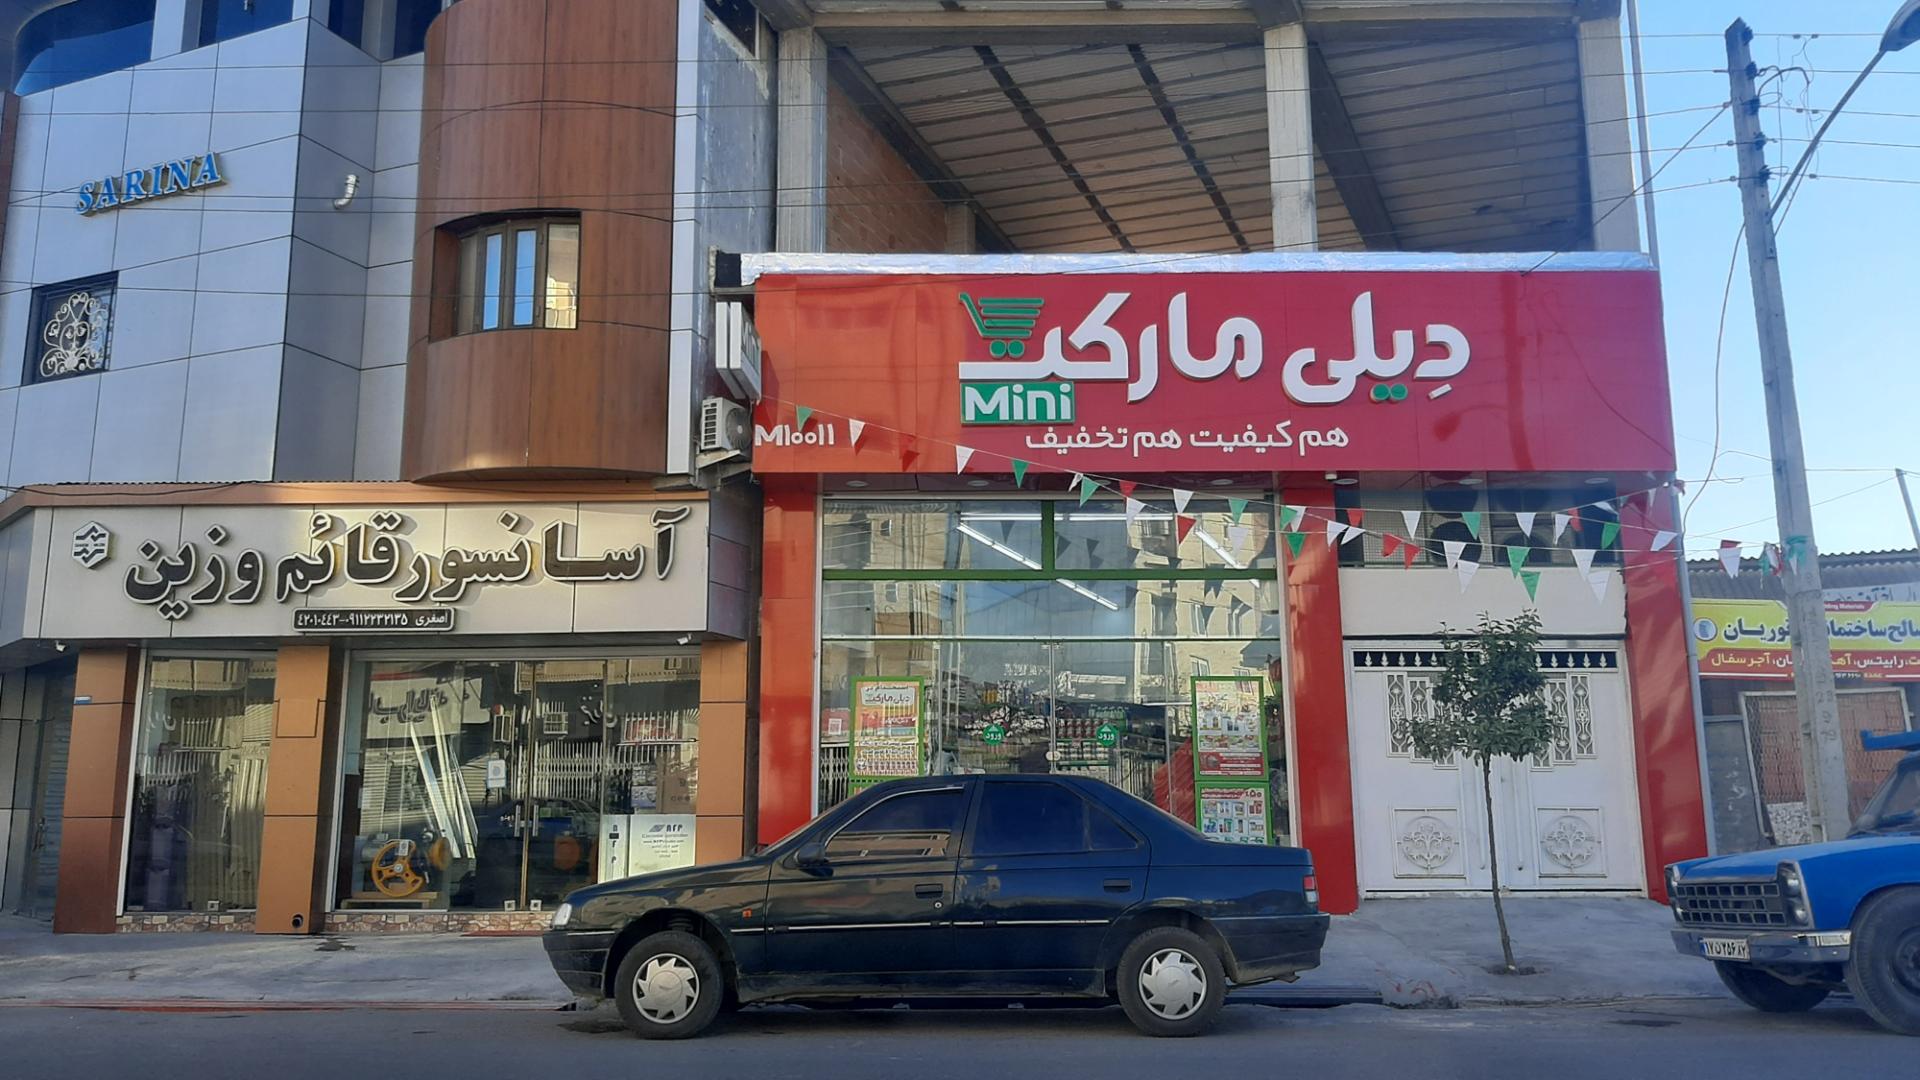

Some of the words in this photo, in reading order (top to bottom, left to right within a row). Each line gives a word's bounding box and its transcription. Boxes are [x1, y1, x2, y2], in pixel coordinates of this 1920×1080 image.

[76, 152, 221, 214] SARINA
[958, 291, 1263, 402] مارکت
[965, 384, 1071, 420] Mini
[1026, 426, 1128, 454] تخفیف
[1133, 430, 1182, 457] هم
[1189, 420, 1293, 453] کیفیت
[1299, 427, 1349, 456] هم
[275, 511, 401, 603] قائم
[392, 505, 691, 602] آسانسور
[415, 611, 447, 627] اصغری
